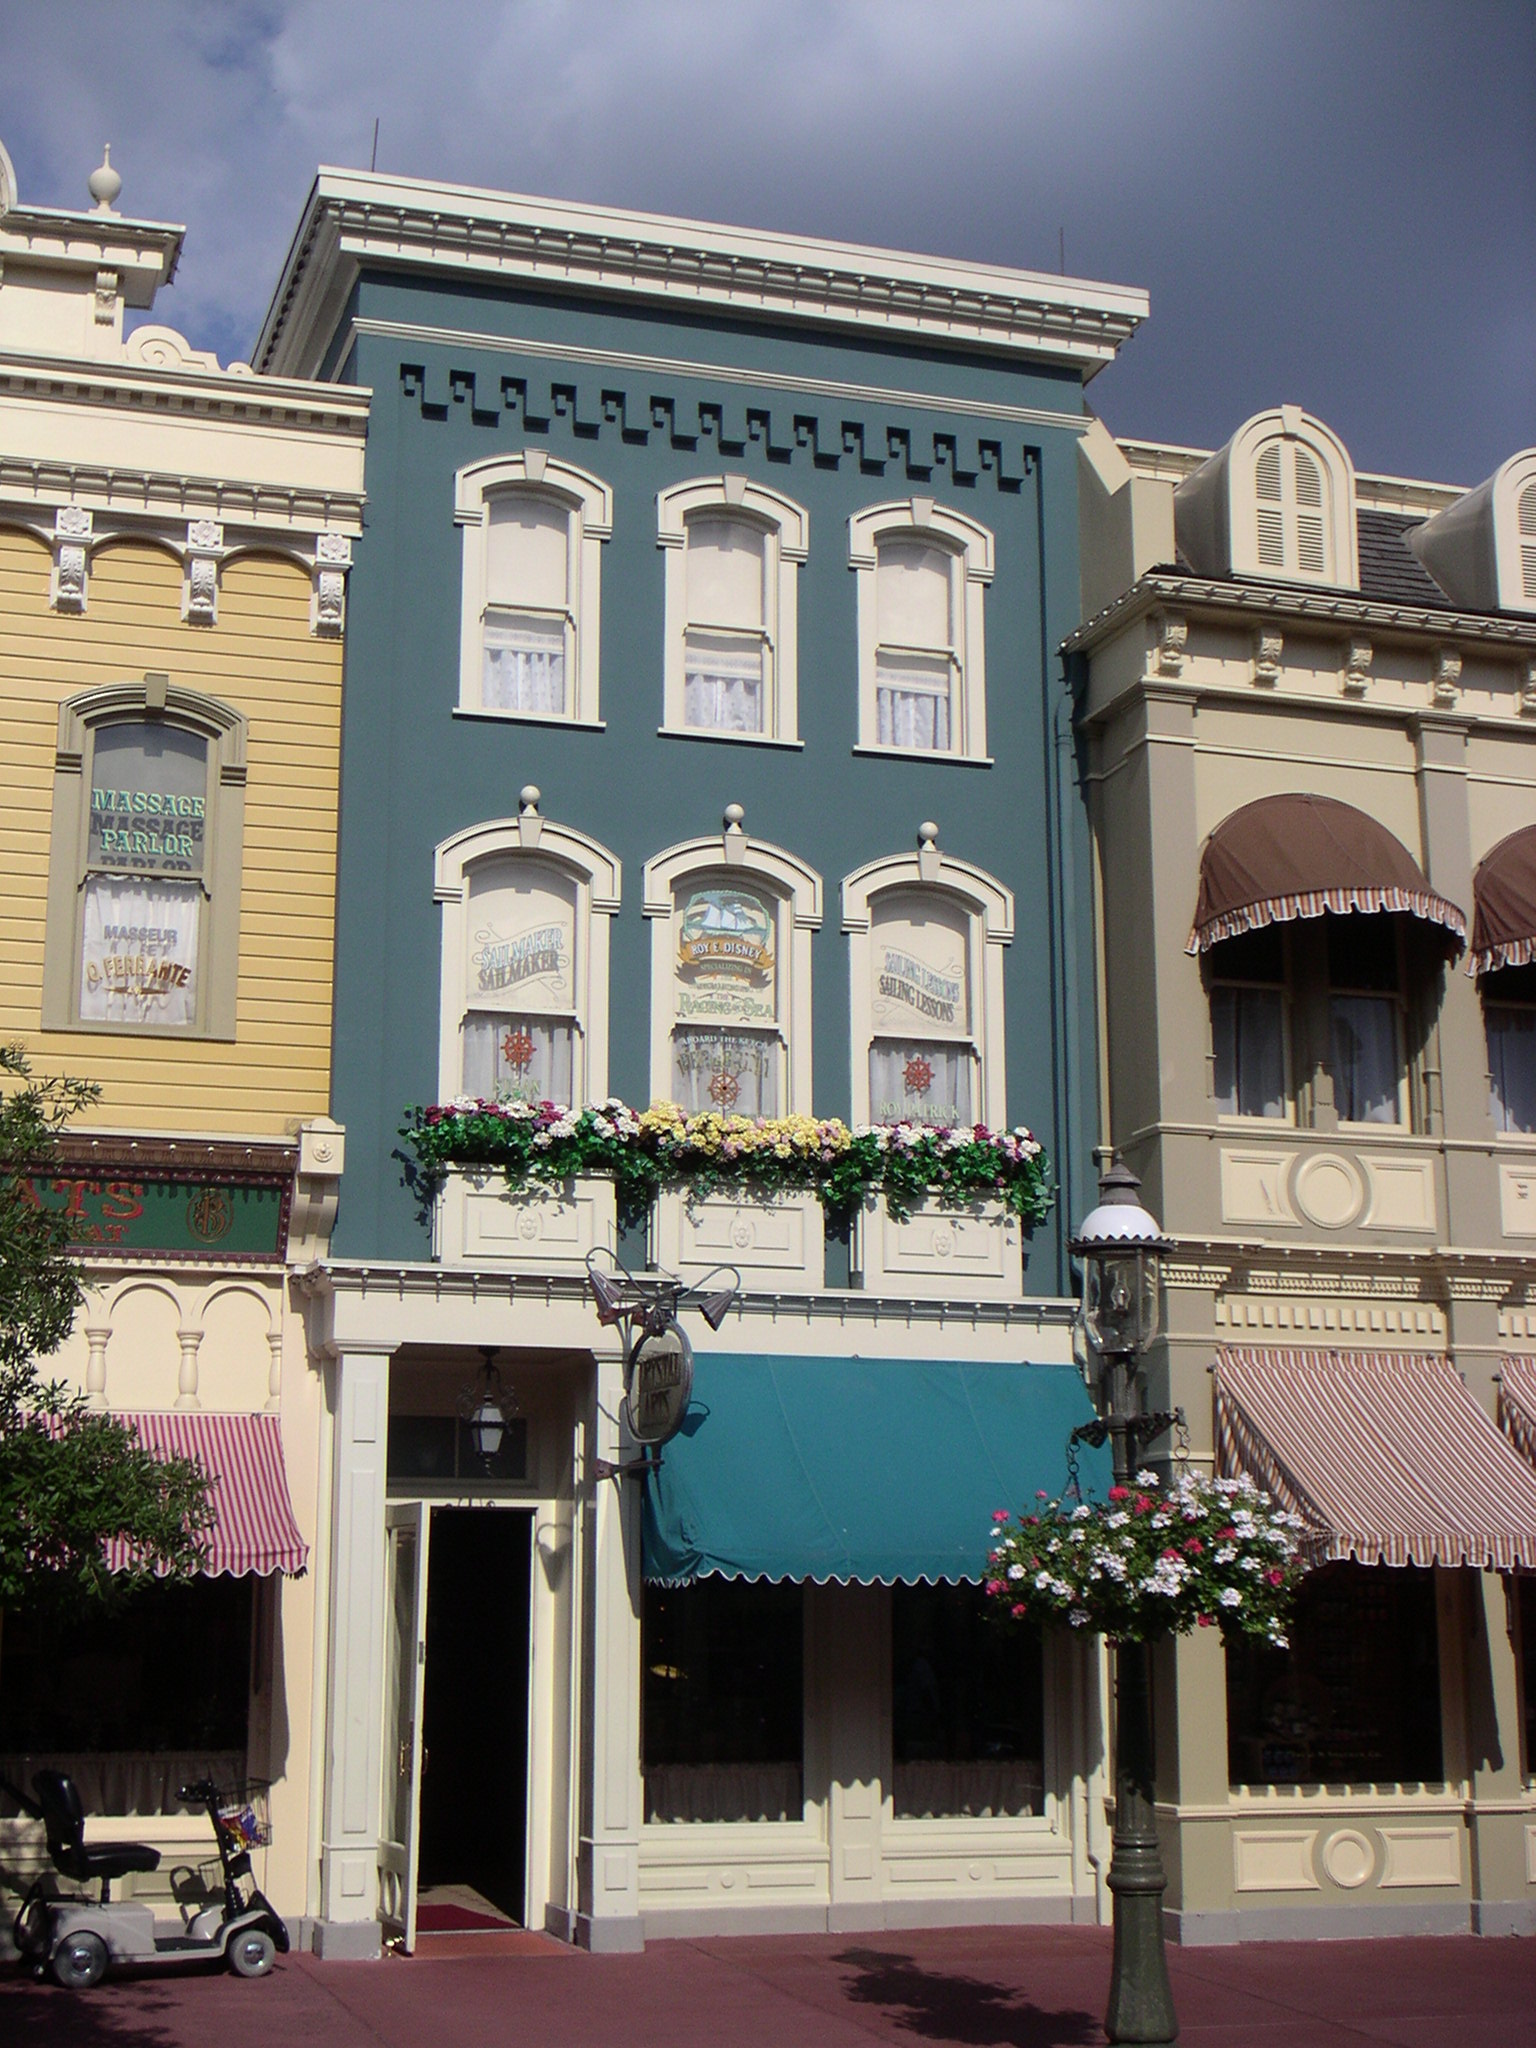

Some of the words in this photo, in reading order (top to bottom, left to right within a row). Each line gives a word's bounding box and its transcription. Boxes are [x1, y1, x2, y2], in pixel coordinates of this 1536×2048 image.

[91, 788, 205, 818] MASSAGE
[100, 829, 193, 857] PARLOR
[104, 925, 178, 944] MASSEUR
[691, 943, 709, 955] ROY
[724, 943, 762, 959] DISNEY
[103, 955, 192, 987] FERRANTE
